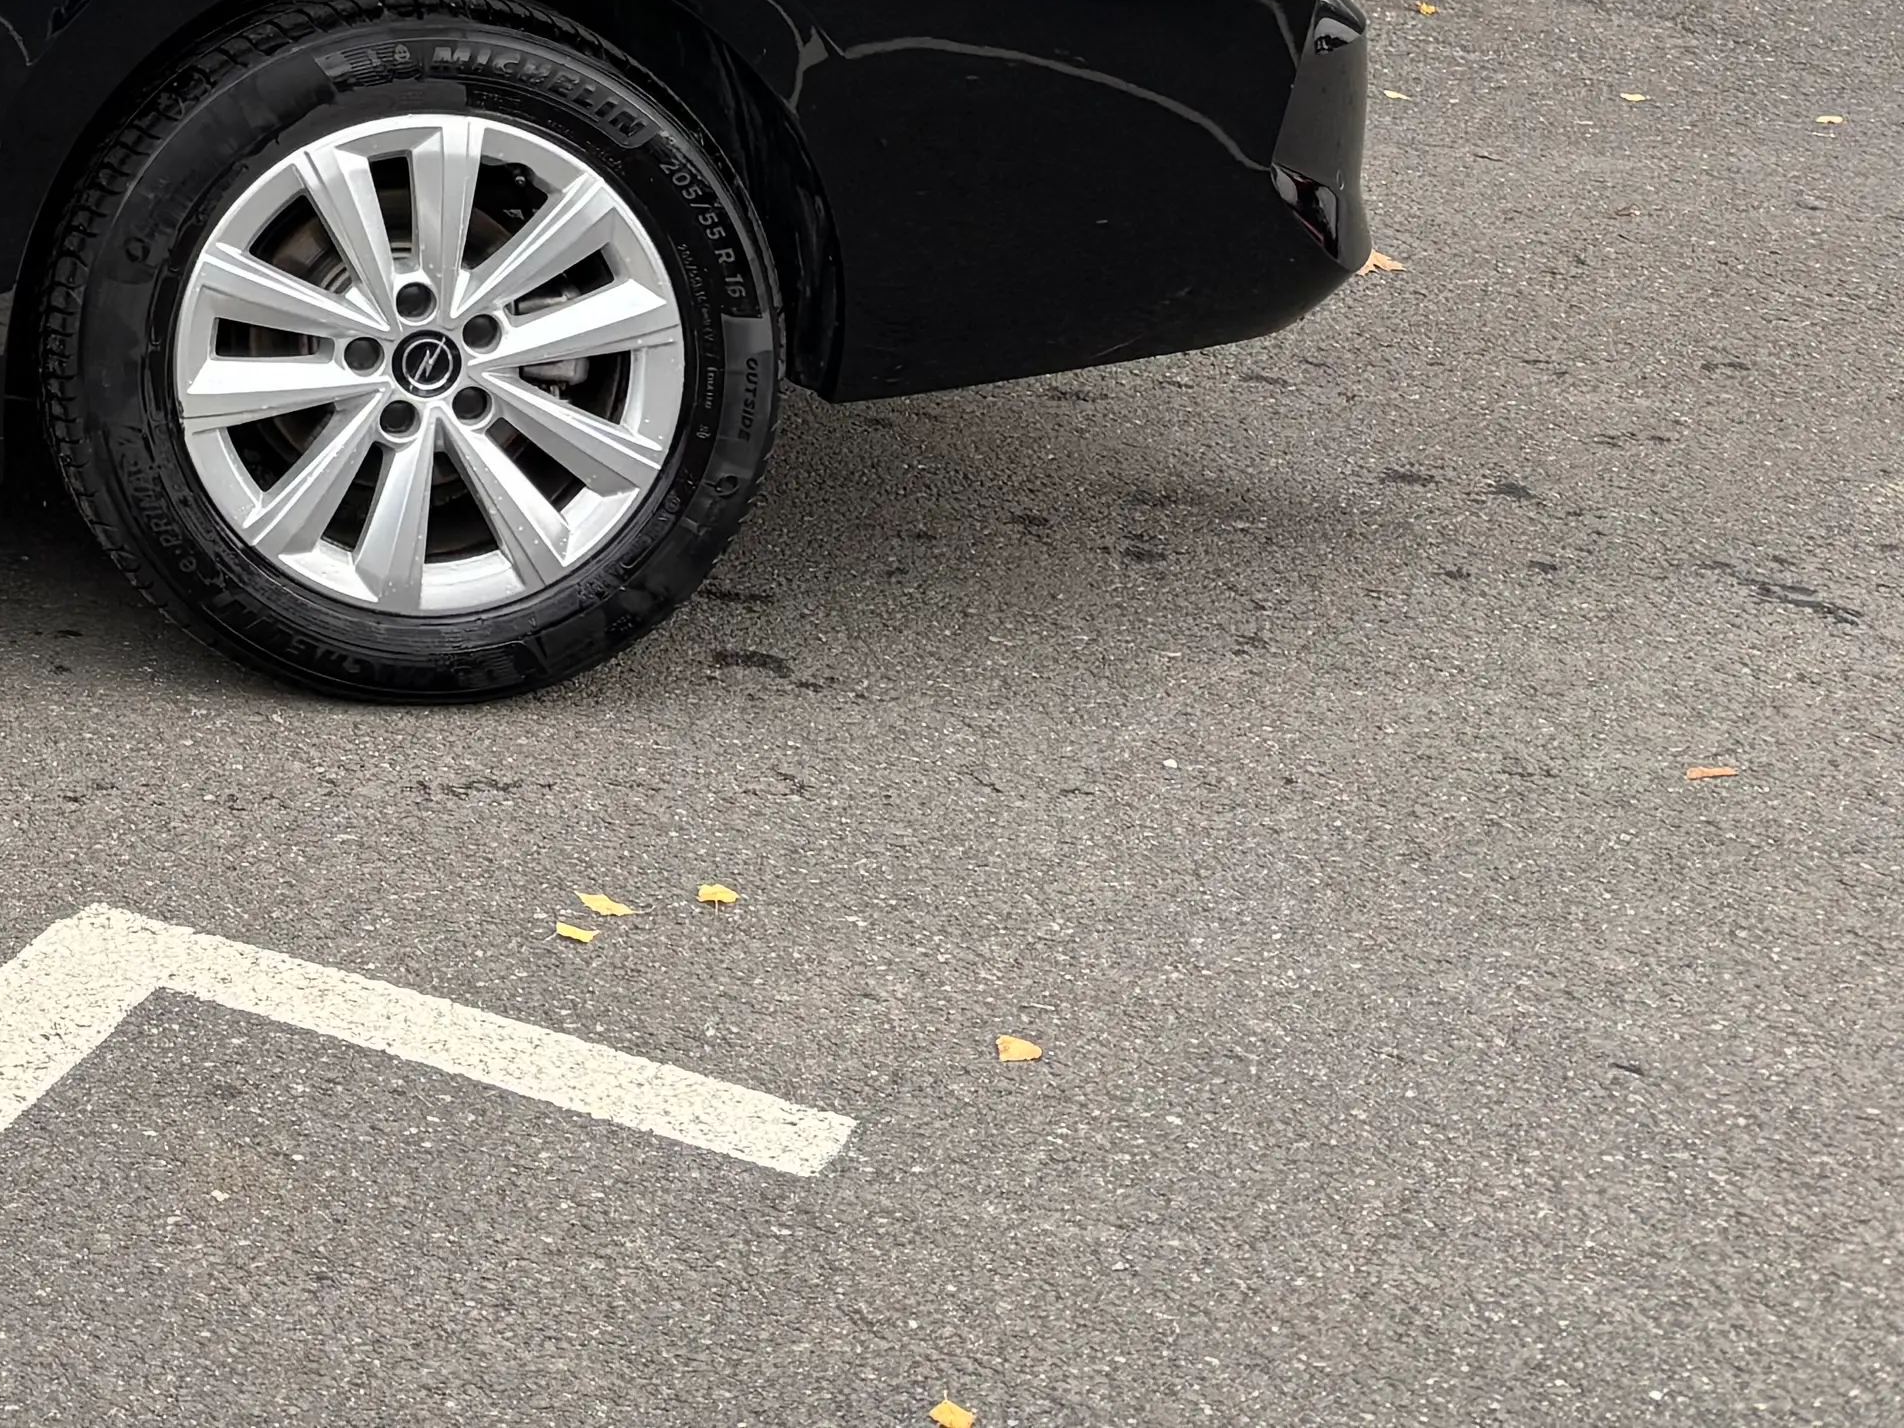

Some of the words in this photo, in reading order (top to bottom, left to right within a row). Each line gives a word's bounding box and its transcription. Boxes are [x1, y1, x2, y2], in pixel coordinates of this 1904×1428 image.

[432, 46, 647, 138] MICHELIN
[659, 158, 726, 241] 205/55
[714, 247, 736, 264] R
[724, 272, 746, 298] 16
[738, 356, 759, 442] OUTSIDE
